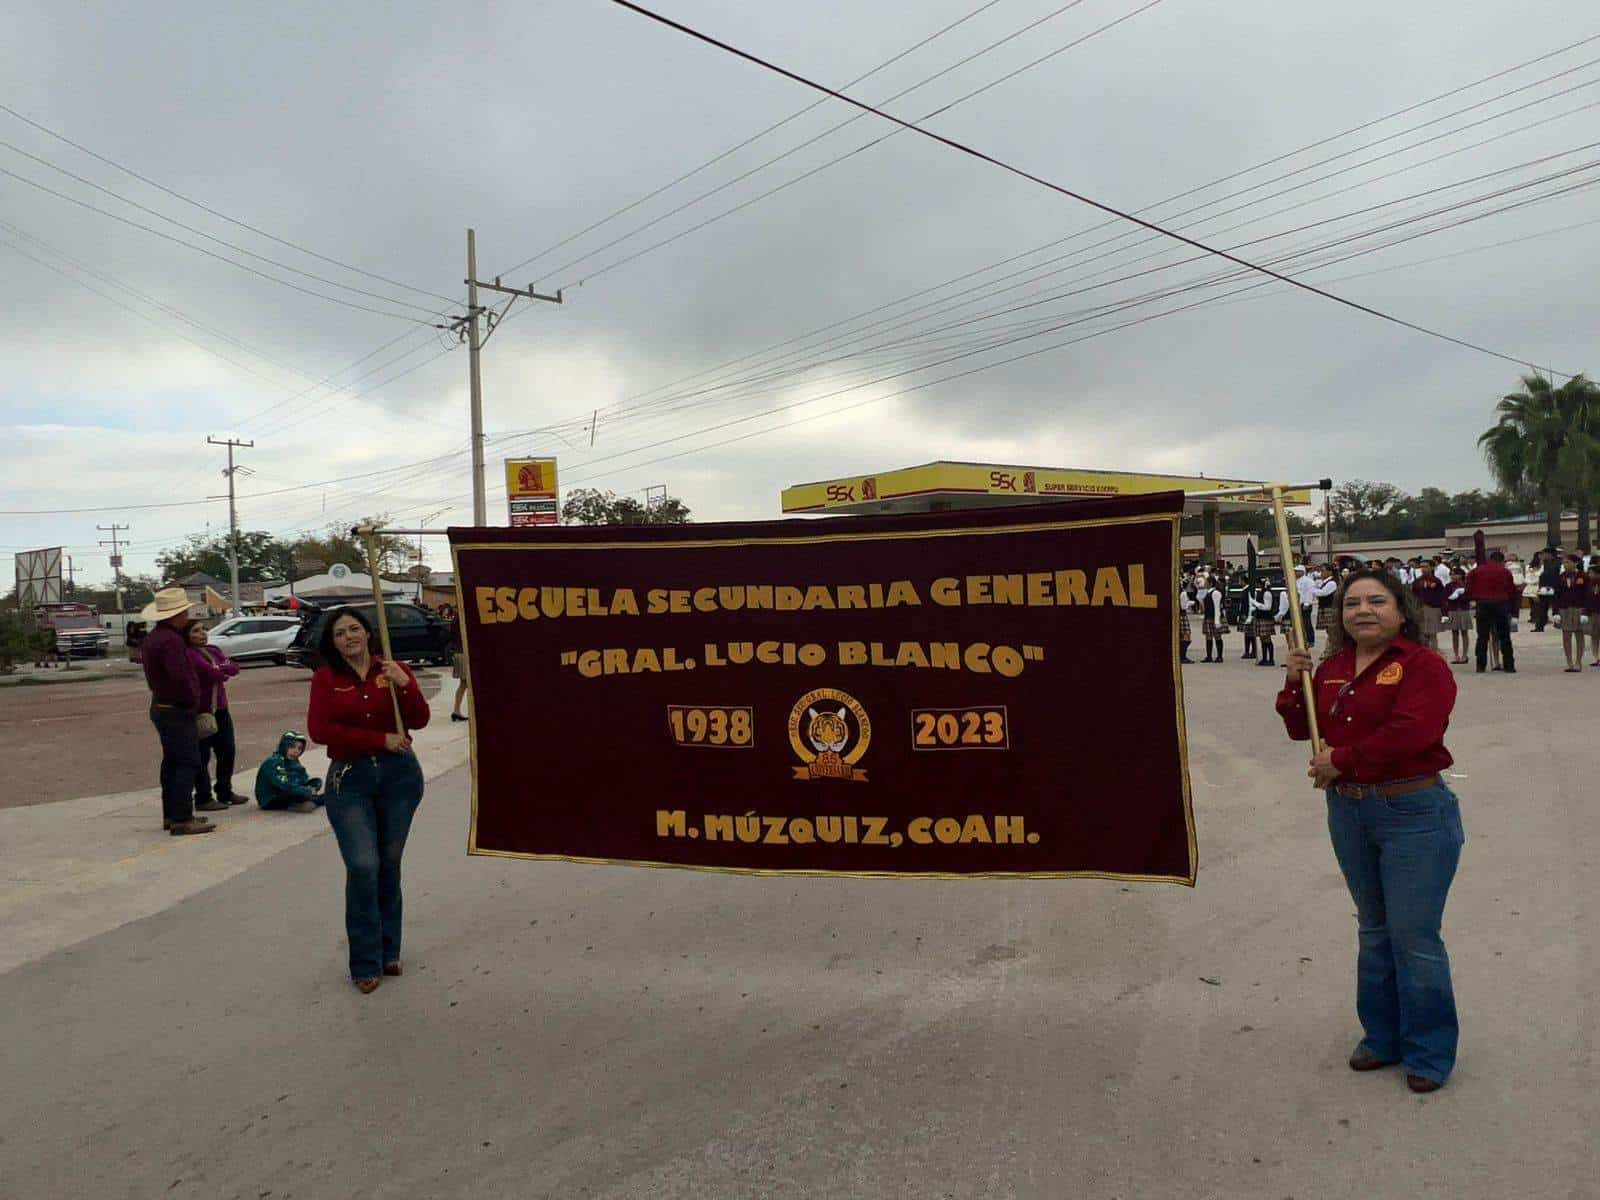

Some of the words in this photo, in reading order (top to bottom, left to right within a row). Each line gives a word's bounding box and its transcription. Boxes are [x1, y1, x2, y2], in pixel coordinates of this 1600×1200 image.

[475, 586, 640, 624] ESCUELA
[647, 579, 922, 616] SECUNDARIA
[930, 563, 1158, 609] GENERAL
[561, 648, 697, 678] "GRAL.
[704, 641, 826, 668] LUCIO
[837, 641, 1045, 678] BLANCO"
[670, 709, 753, 746] 1938
[915, 711, 1005, 746] 2023
[656, 810, 699, 839] M.
[907, 815, 1041, 845] COAH.
